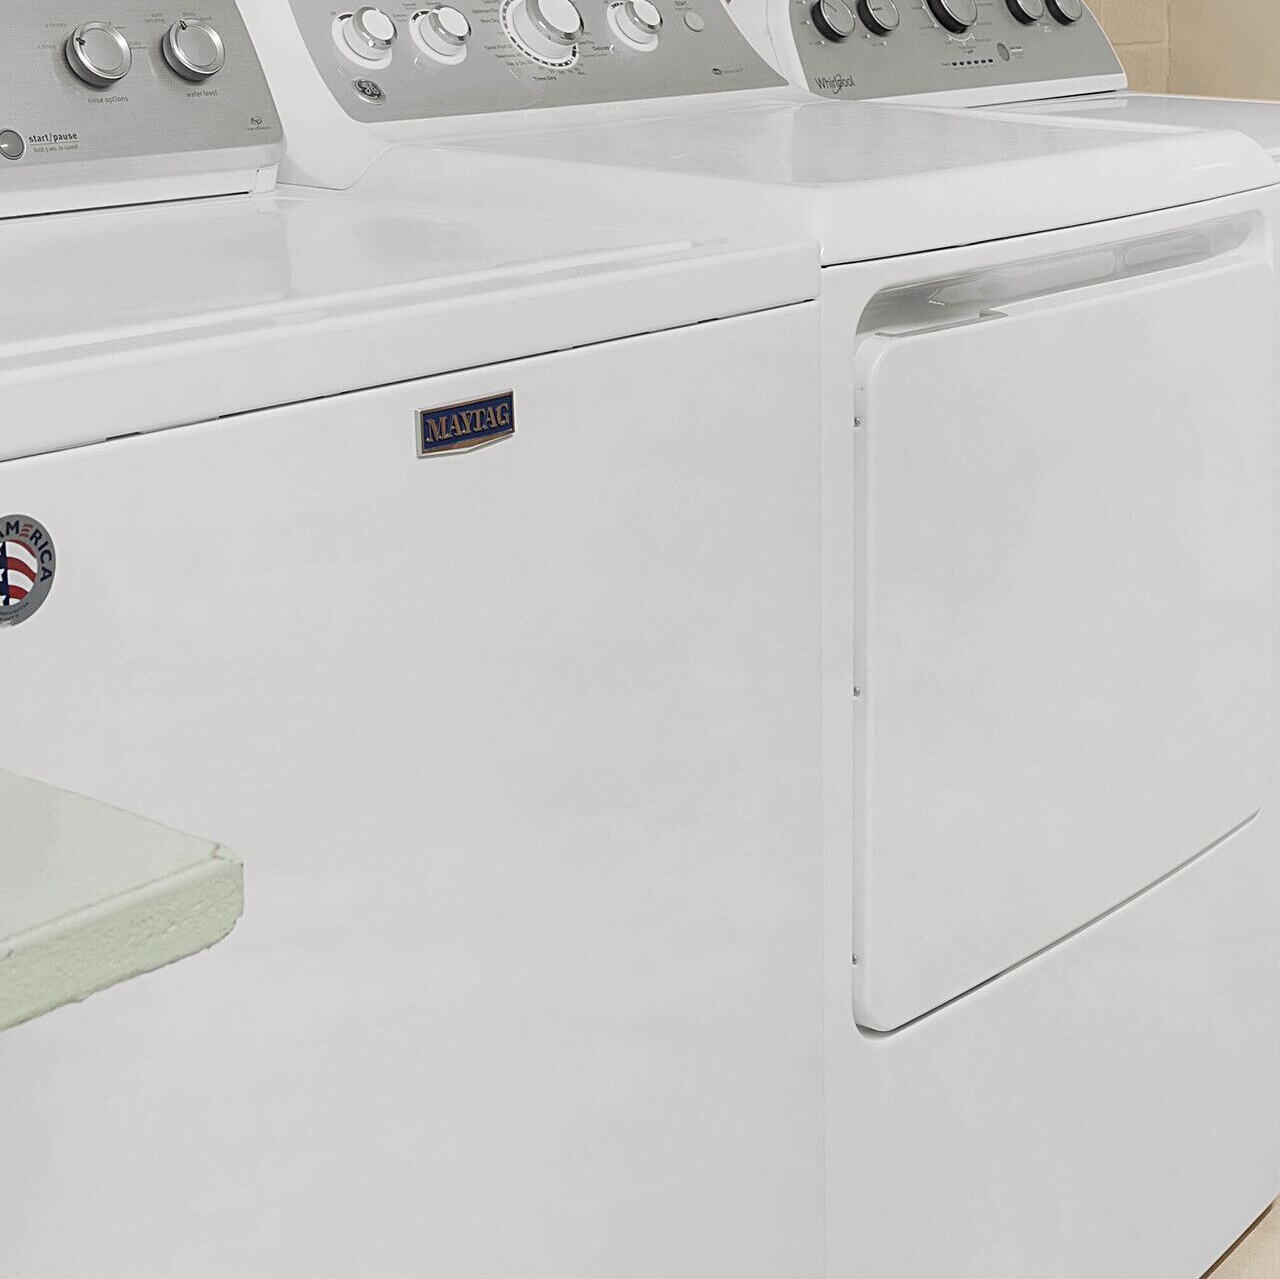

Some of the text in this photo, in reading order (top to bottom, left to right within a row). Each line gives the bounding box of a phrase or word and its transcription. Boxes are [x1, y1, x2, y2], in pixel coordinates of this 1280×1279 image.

[814, 73, 856, 95] Whirlpool
[28, 132, 78, 143] start/pause
[425, 402, 510, 443] MAYTAG
